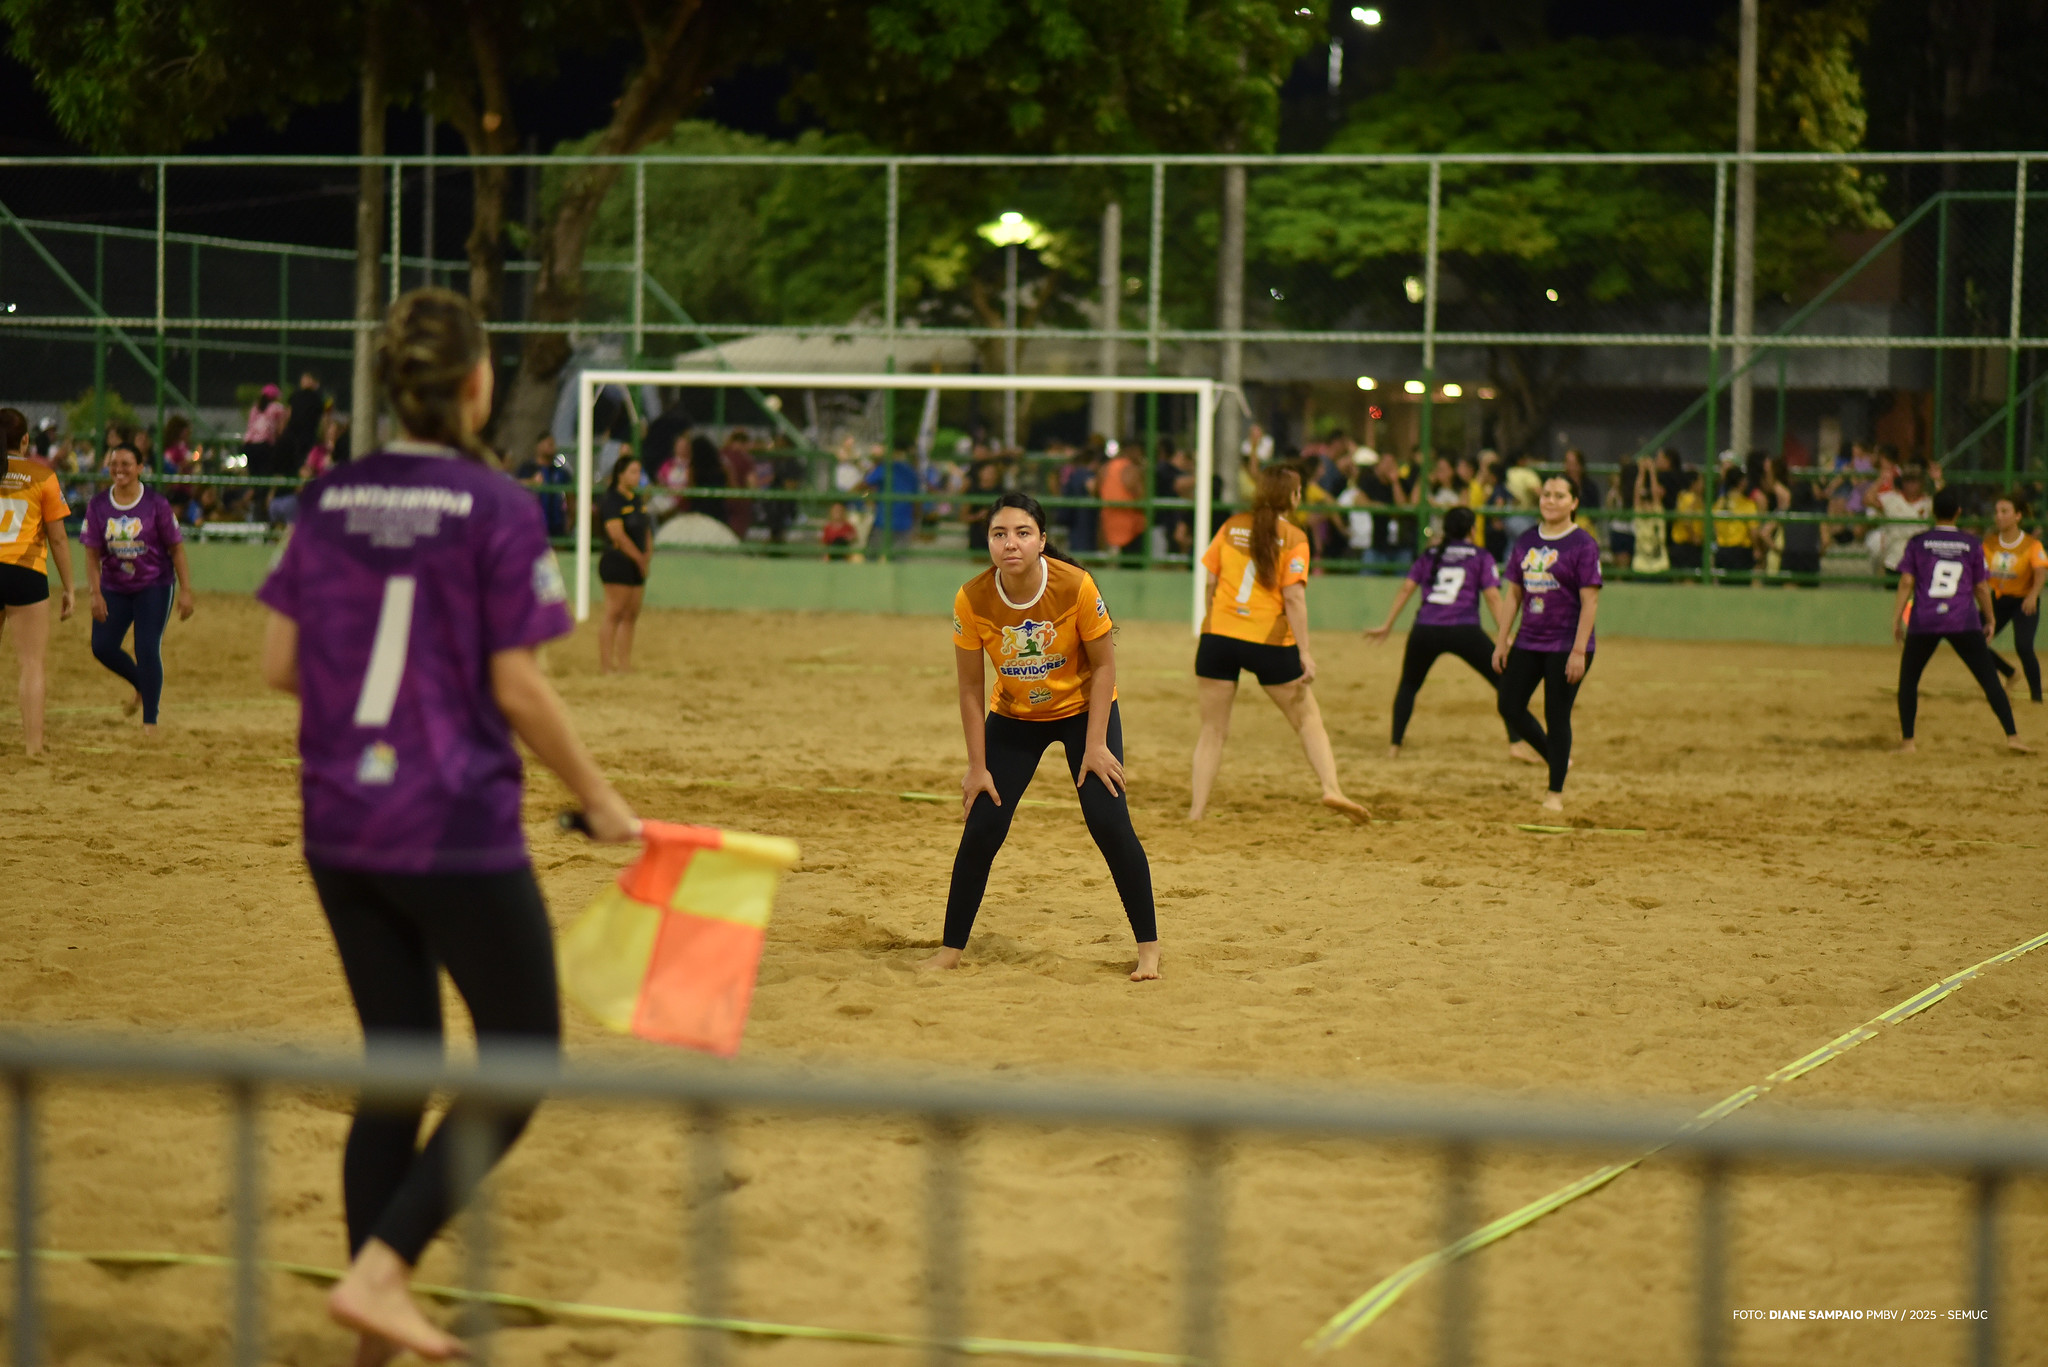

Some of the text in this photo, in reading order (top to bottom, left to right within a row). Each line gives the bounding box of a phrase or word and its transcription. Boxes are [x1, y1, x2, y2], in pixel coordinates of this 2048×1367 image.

[1236, 559, 1257, 604] 1
[1427, 567, 1466, 605] 9
[1928, 560, 1963, 599] 8
[353, 574, 416, 728] 1
[1000, 657, 1066, 675] SERVIDORES
[1004, 655, 1060, 667] JOGOS DOS
